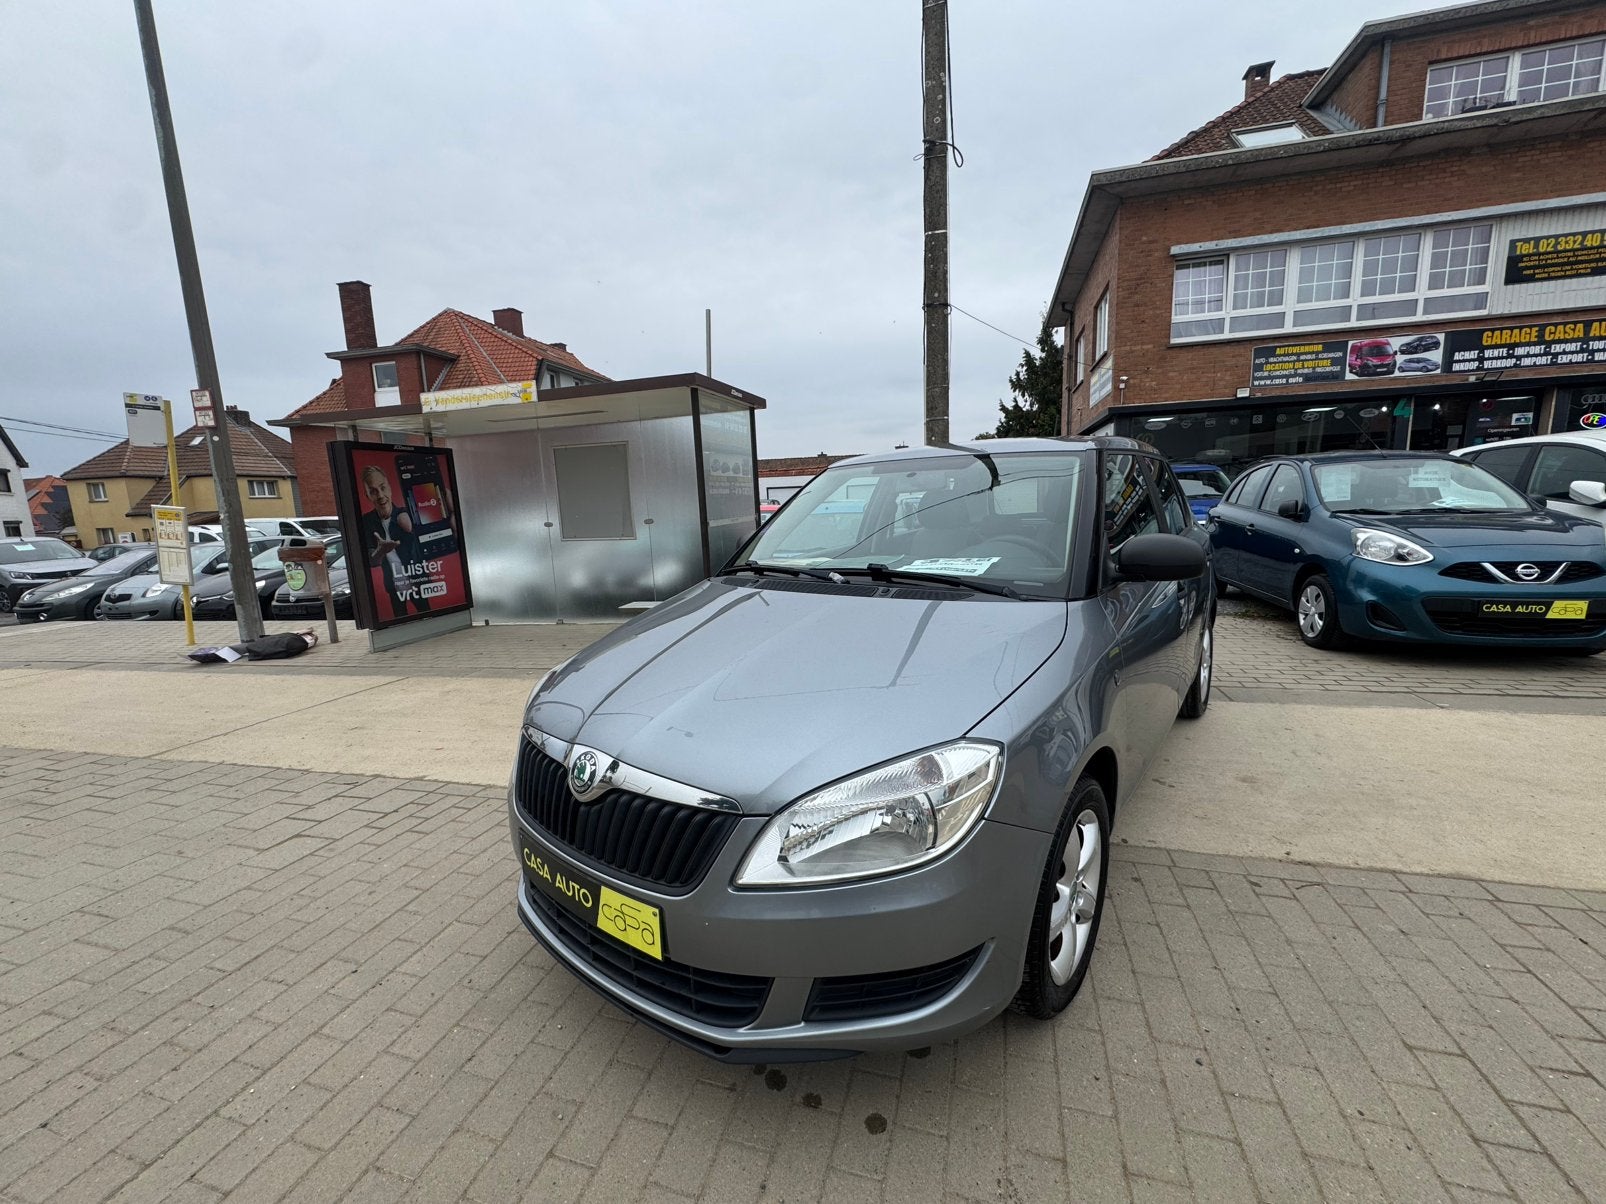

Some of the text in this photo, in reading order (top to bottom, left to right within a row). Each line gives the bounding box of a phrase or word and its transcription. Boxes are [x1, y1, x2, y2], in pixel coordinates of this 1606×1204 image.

[1515, 240, 1536, 255] Tel.
[1538, 238, 1556, 252] 02
[1557, 235, 1583, 250] 332
[1584, 232, 1601, 247] 40
[1482, 326, 1539, 346] GARAGE
[1544, 323, 1584, 340] CASA
[1275, 344, 1323, 355] AUTOVERHUUR
[1453, 350, 1480, 361] ACHAT
[1484, 347, 1508, 358] VENTE
[1514, 345, 1545, 356] IMPORT
[1550, 342, 1582, 353] EXPORT
[1263, 359, 1332, 371] LOCATION DE VOITURE
[1452, 361, 1479, 371] INKOOP
[1483, 358, 1516, 369] VERKOOP
[1520, 355, 1552, 366] IMPORT
[1557, 352, 1588, 363] EXPORT
[391, 559, 443, 579] Luister
[396, 584, 445, 602] vrt max
[1482, 603, 1512, 613] CASA
[1515, 603, 1546, 614] AUTO
[523, 846, 552, 883] CASA
[555, 871, 593, 909] AUTO
